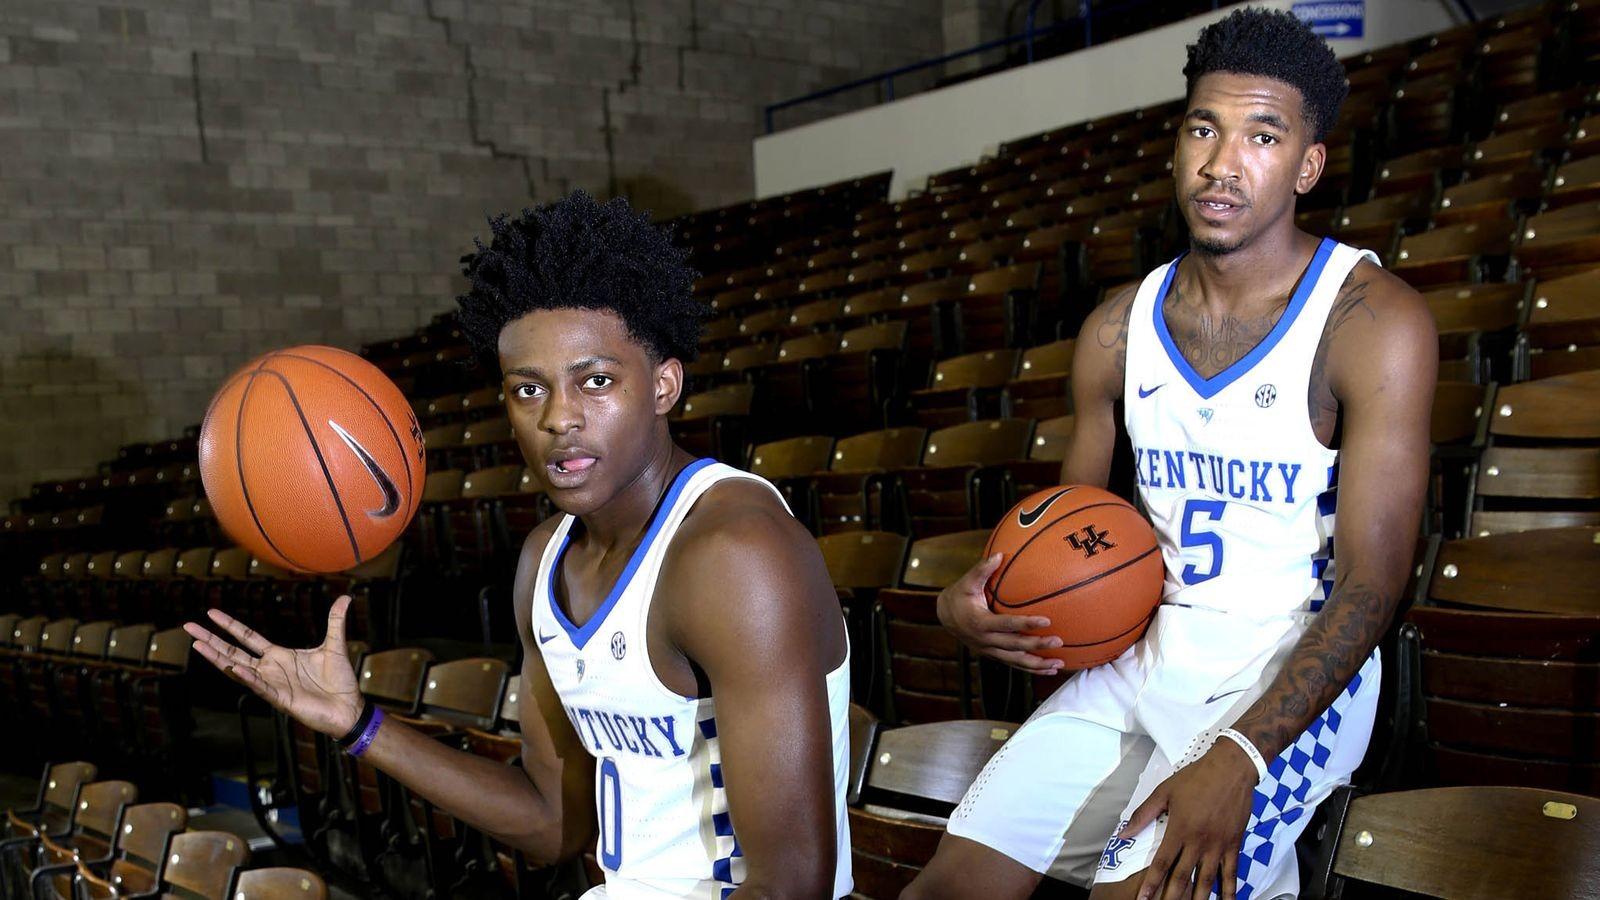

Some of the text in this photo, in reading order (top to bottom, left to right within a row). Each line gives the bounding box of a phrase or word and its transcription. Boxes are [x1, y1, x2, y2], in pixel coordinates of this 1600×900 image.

[1255, 384, 1276, 408] SEC
[1135, 447, 1301, 504] KENTUCKY
[1063, 524, 1117, 559] UK
[1180, 499, 1228, 586] 5
[601, 757, 623, 873] 0
